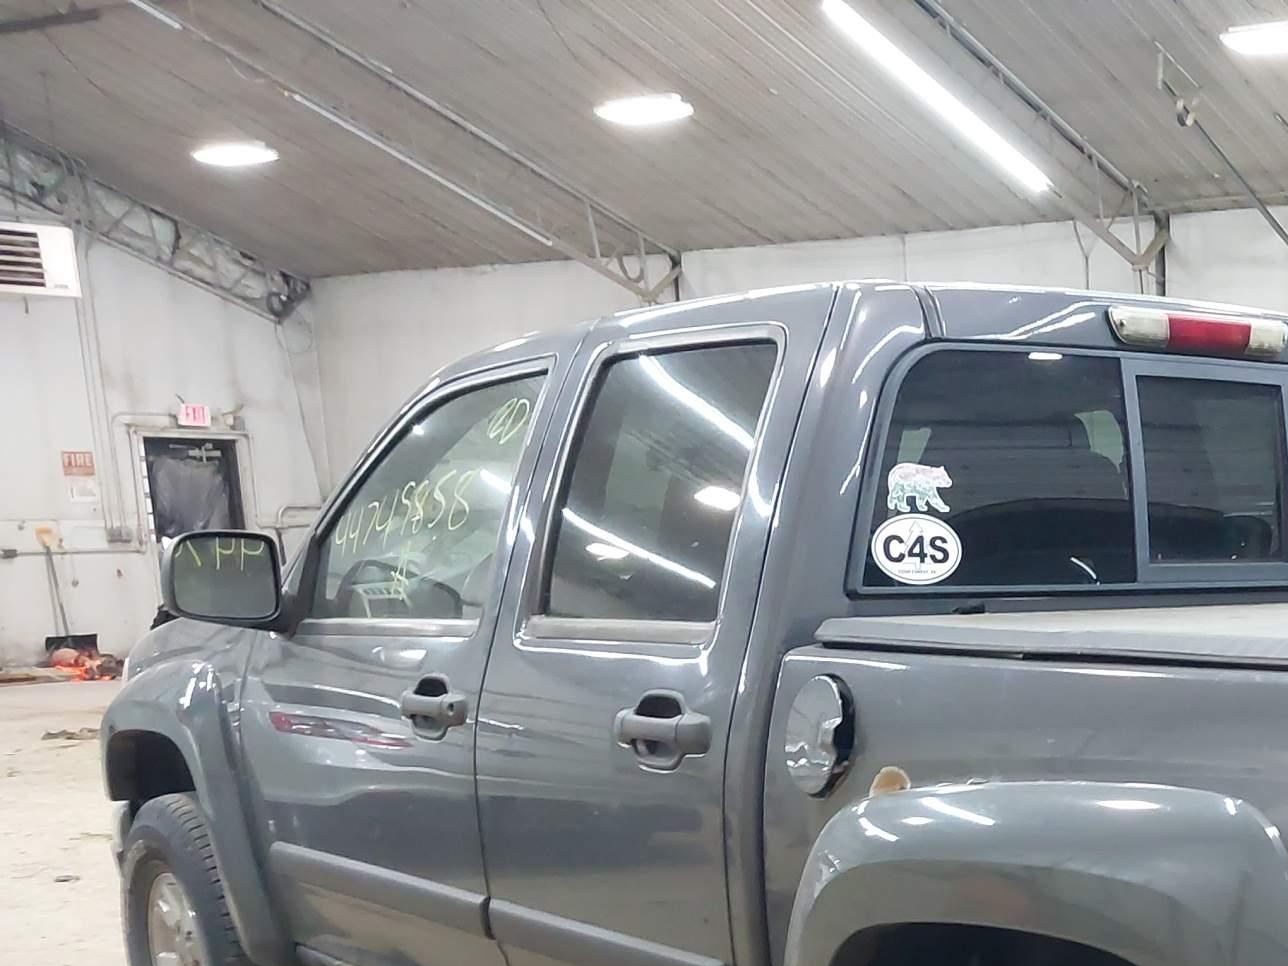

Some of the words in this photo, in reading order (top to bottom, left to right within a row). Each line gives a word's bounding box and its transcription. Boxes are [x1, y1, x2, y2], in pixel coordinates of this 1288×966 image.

[184, 405, 206, 424] EXIT
[63, 453, 93, 467] FIRE
[882, 533, 951, 565] C4S
